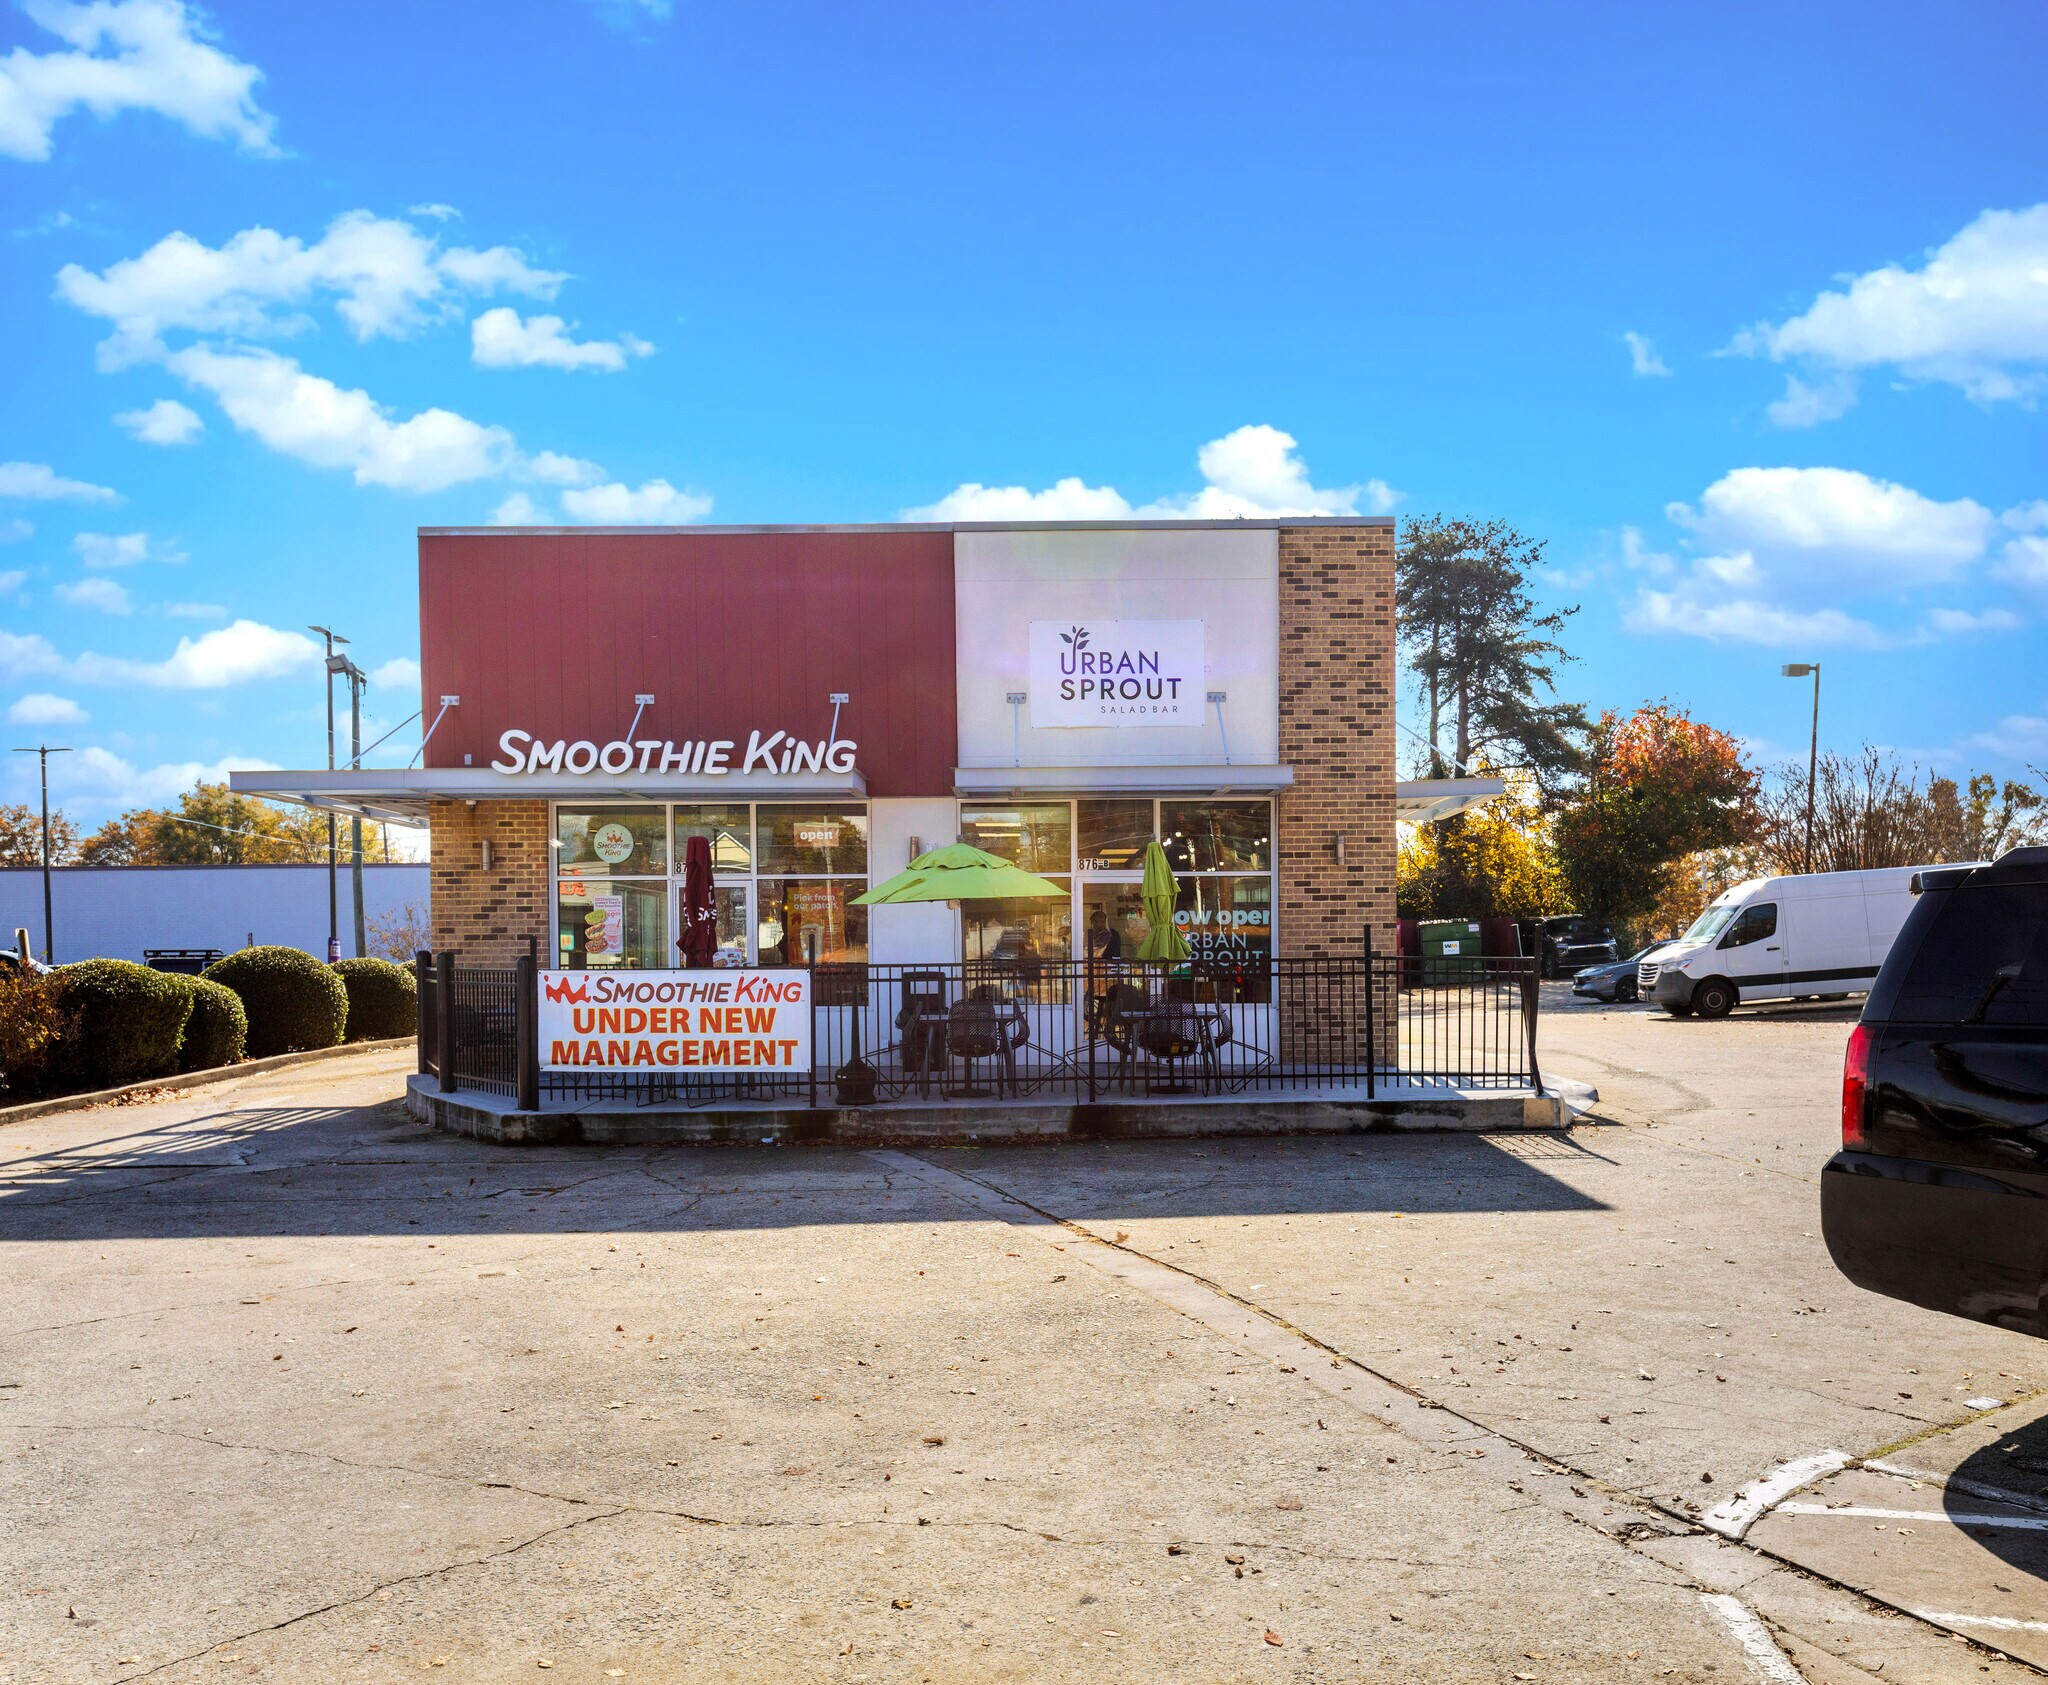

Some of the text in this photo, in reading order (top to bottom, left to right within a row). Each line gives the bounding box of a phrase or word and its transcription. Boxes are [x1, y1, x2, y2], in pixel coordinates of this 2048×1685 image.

[1060, 649, 1159, 675] URBAN
[1060, 677, 1182, 701] SPROUT
[491, 729, 735, 775] SMOOTHIE
[800, 830, 833, 842] open
[597, 841, 632, 850] SMOOTHIE
[675, 862, 687, 873] 87
[793, 893, 836, 902] Pick from
[1172, 909, 1213, 925] ow
[1189, 931, 1247, 949] RBAN
[1188, 950, 1263, 966] PROUT
[592, 976, 732, 1004] SMOOTHIE
[572, 1007, 777, 1035] UNDER NEW
[551, 1039, 799, 1067] MANAGEMENT
